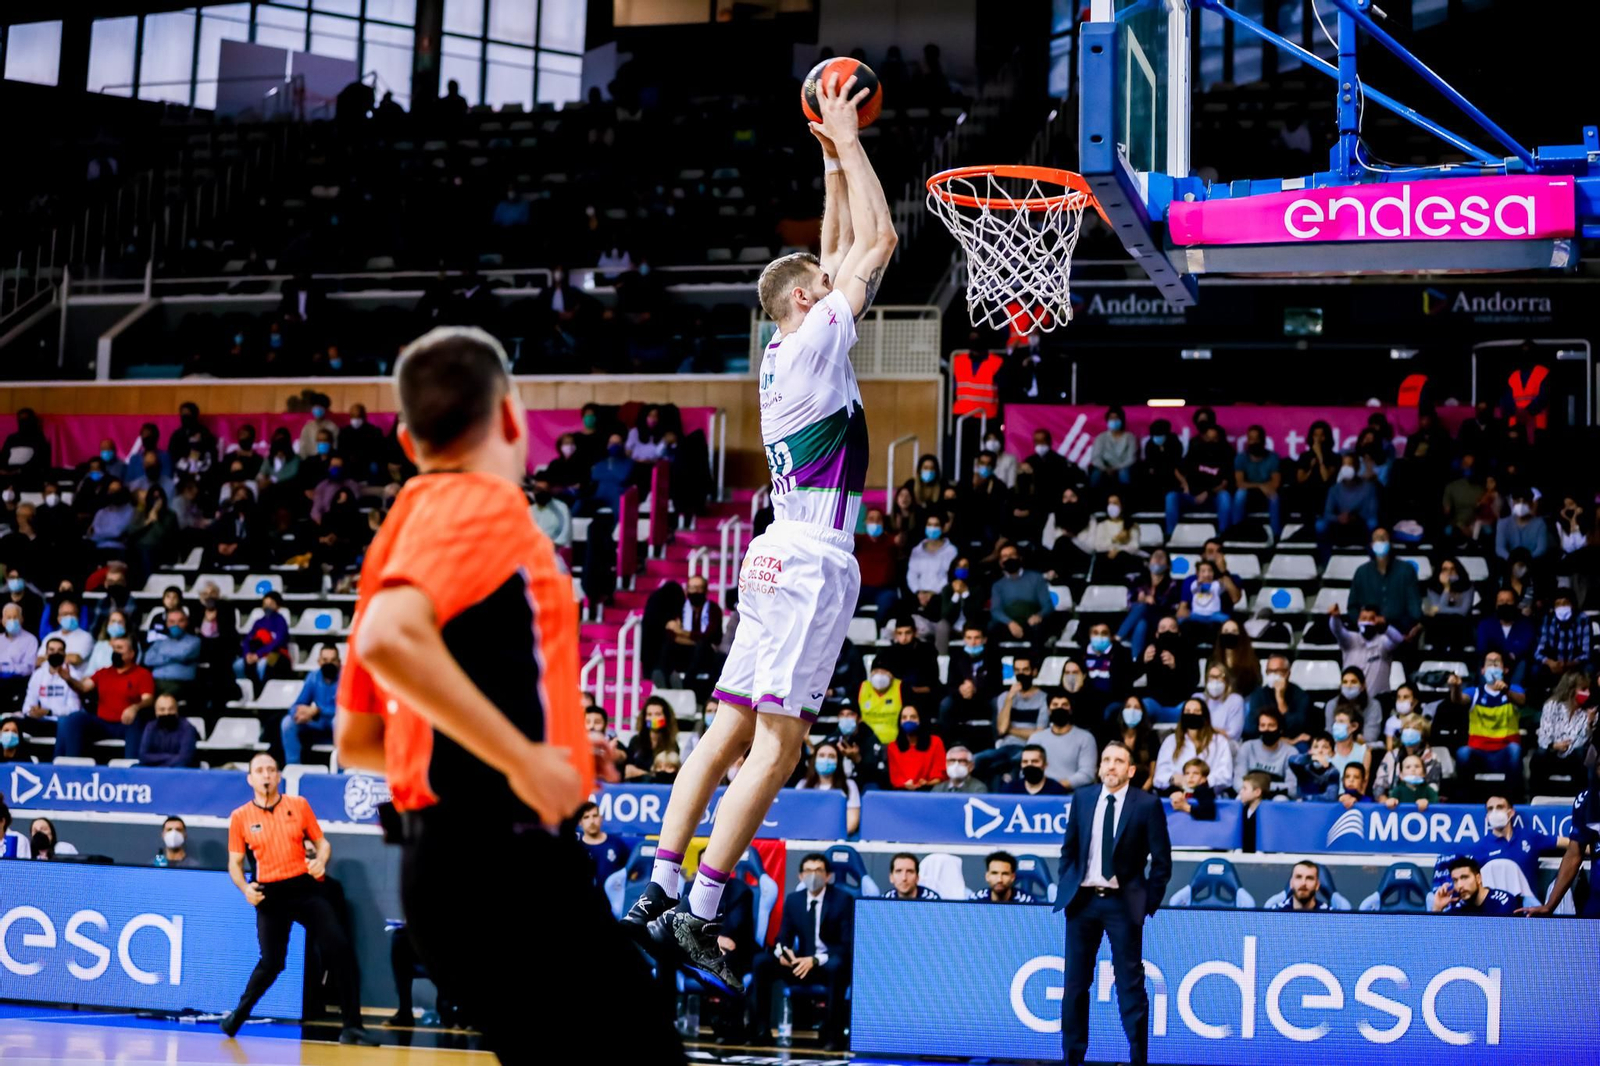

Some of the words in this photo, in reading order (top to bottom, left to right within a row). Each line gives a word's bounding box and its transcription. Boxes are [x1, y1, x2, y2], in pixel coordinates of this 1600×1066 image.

[1284, 185, 1536, 239] endesa
[1451, 291, 1551, 312] Andorra
[758, 570, 777, 584] SOL
[42, 772, 152, 804] Andorra
